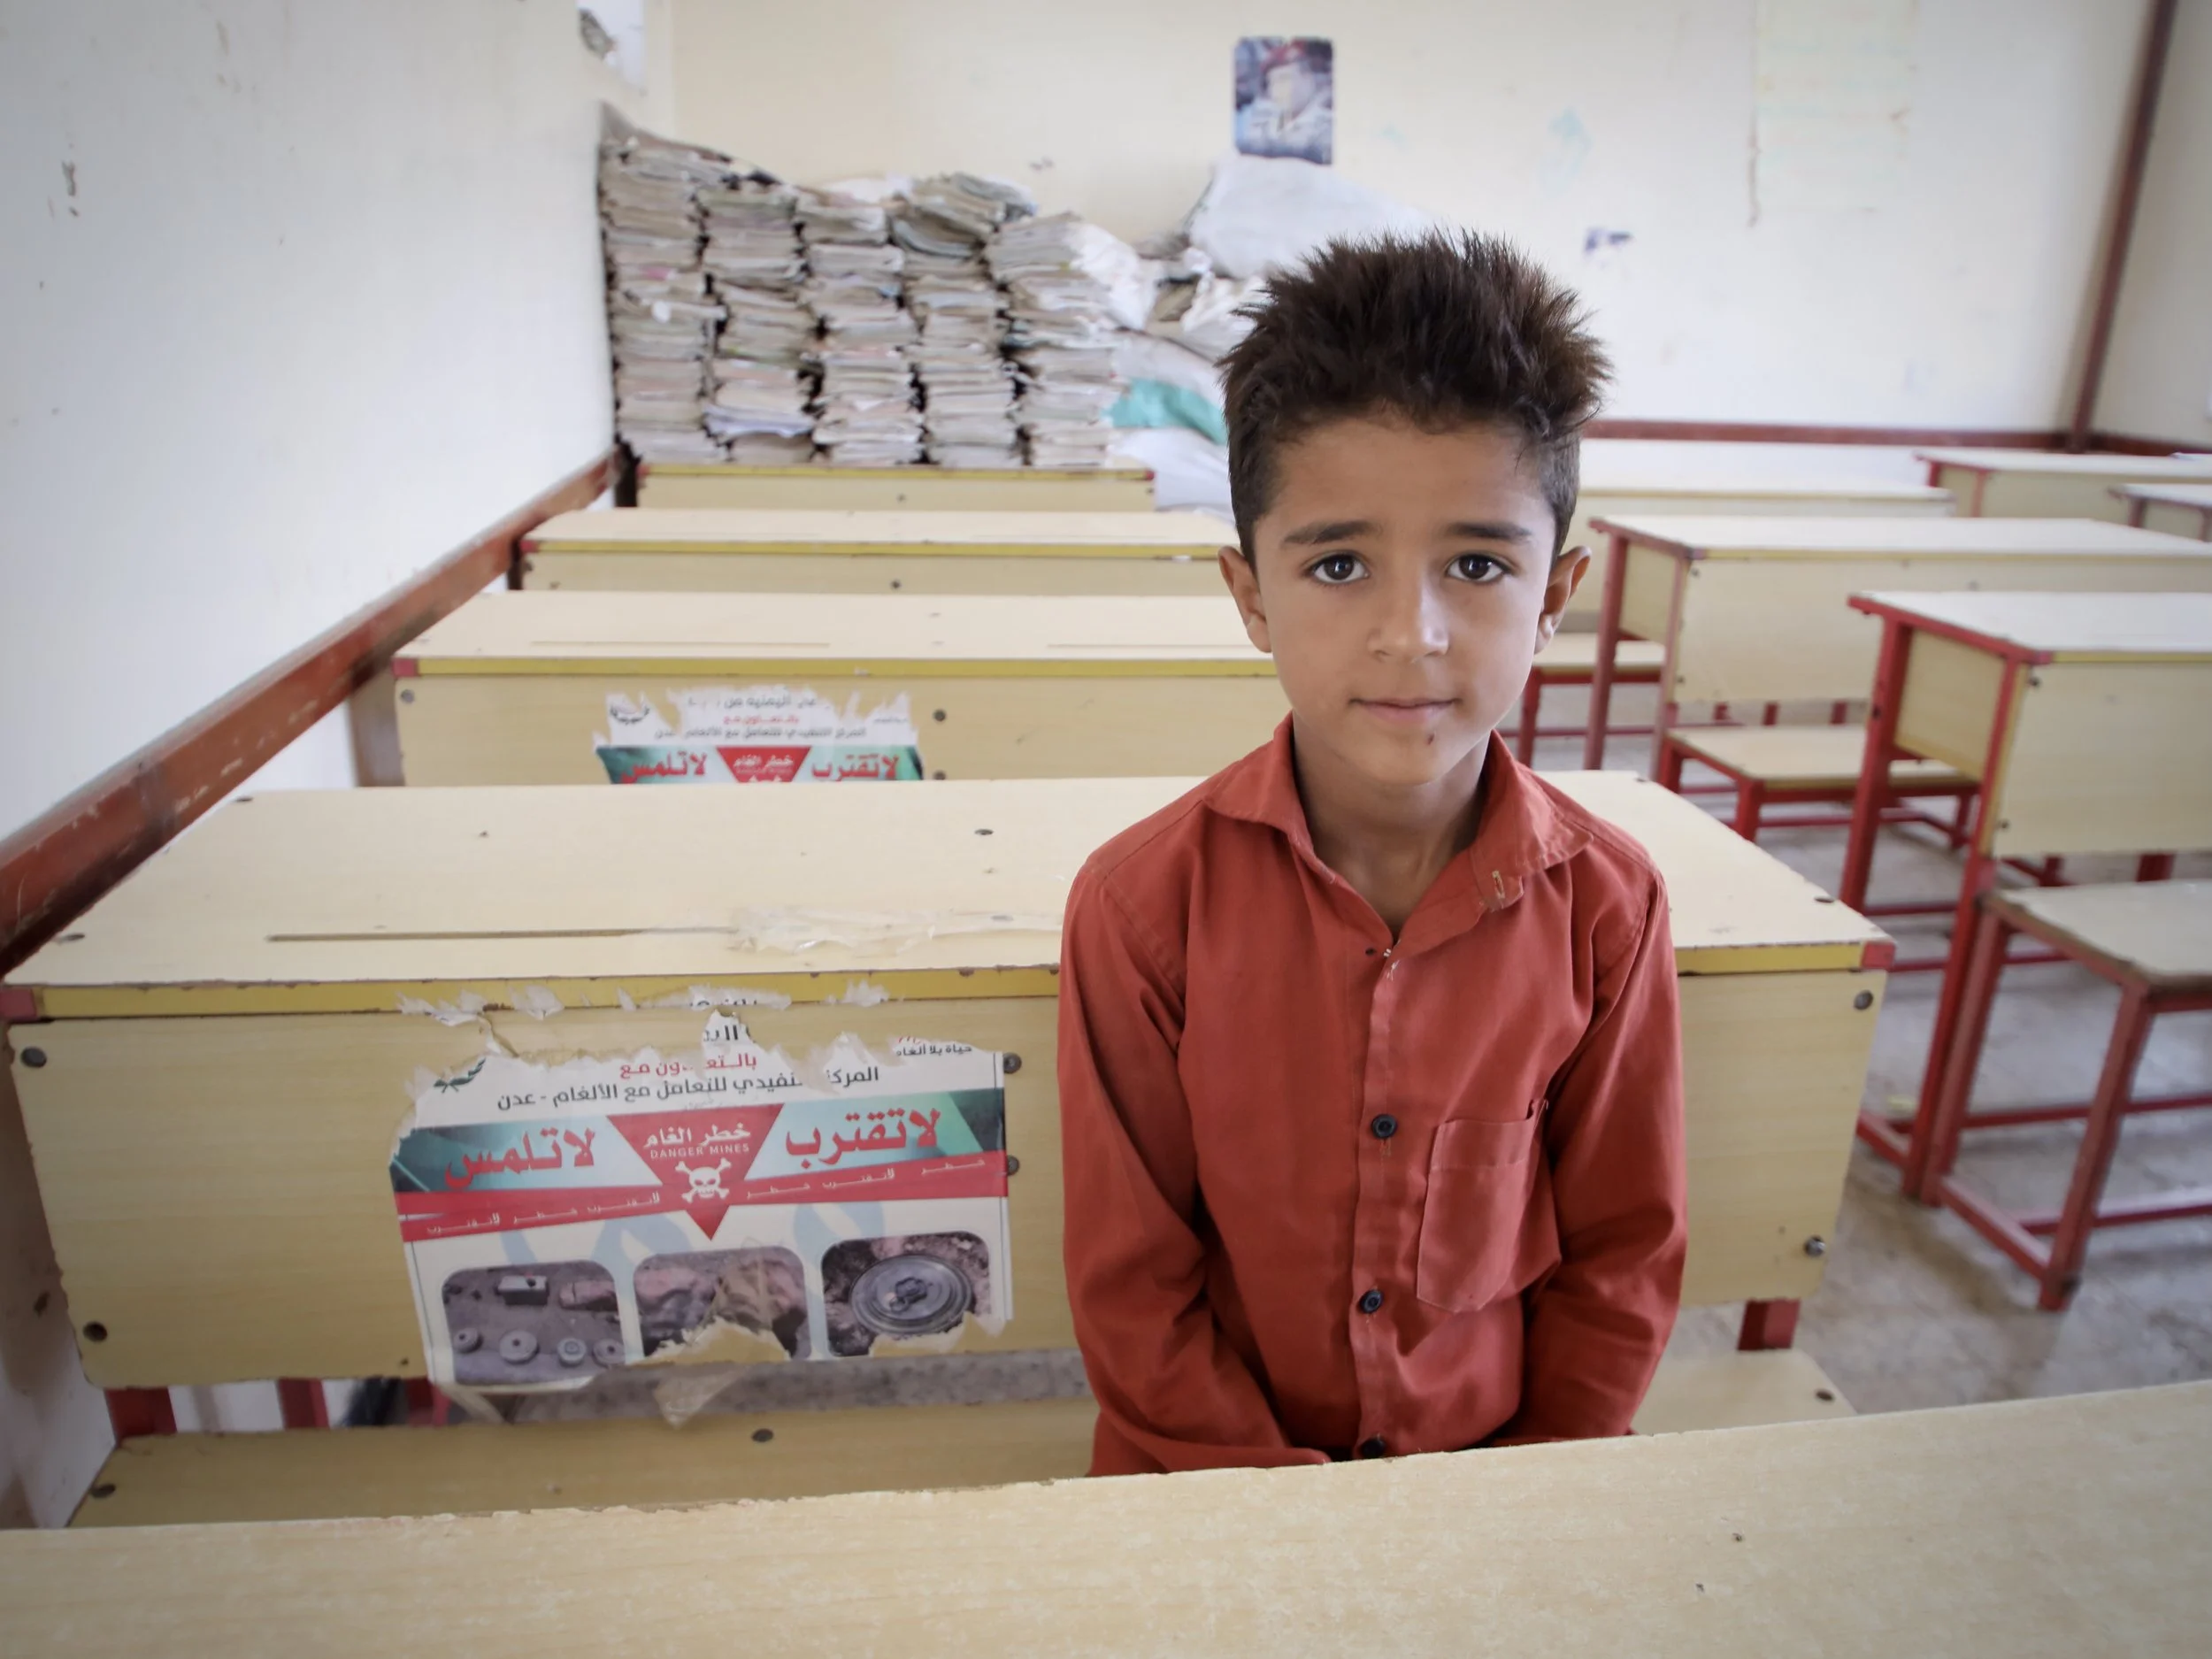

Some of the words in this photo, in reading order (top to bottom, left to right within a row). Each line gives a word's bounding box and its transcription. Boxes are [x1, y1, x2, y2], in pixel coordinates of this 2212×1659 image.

[946, 1043, 972, 1054] حياة
[620, 1063, 650, 1079] مع
[497, 1093, 536, 1110] عدن
[552, 1083, 618, 1107] الألغام
[625, 1085, 650, 1102] مع
[698, 1122, 751, 1147] خطر
[786, 1108, 941, 1170] لاتقترب
[445, 1127, 596, 1190] لاتلمس
[650, 1146, 704, 1159] DANGER
[710, 1142, 749, 1155] MINES
